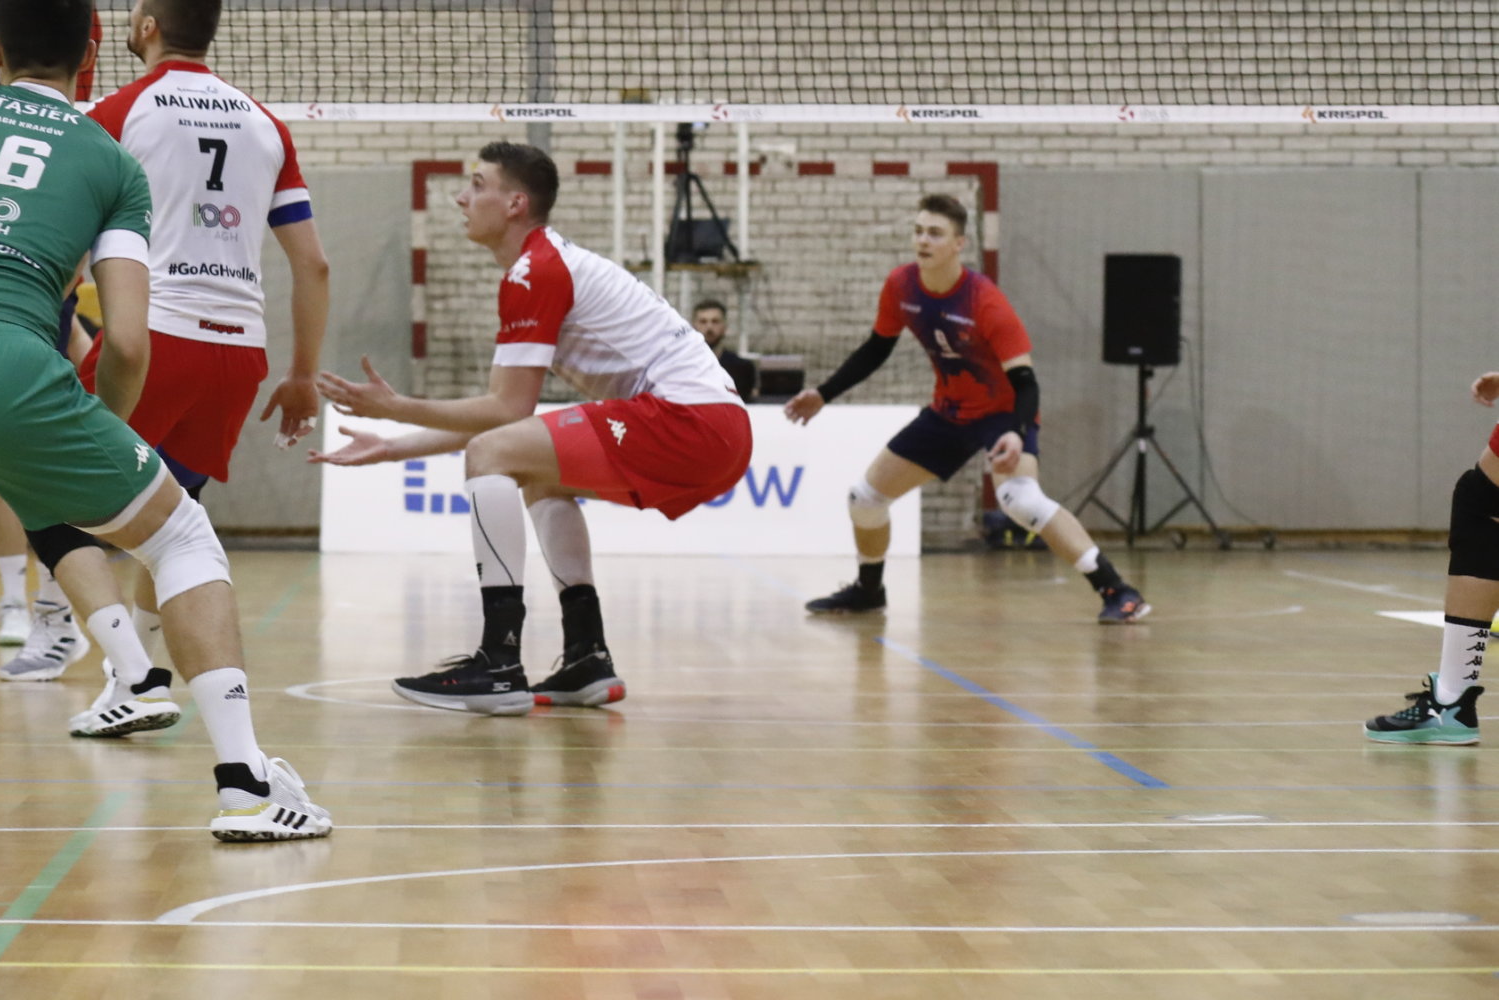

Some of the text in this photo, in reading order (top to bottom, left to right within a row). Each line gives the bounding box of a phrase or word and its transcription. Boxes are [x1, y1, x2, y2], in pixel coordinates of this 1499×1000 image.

[154, 94, 251, 113] NALIWAJKO
[505, 107, 577, 117] KRISPOL
[911, 109, 983, 119] KRISPOL
[1317, 109, 1389, 119] KRISPOL
[18, 120, 65, 136] KRAKÓW
[178, 118, 242, 130] AZS AGH KRAKÓW
[198, 137, 228, 192] 7
[199, 319, 245, 335] Kappa
